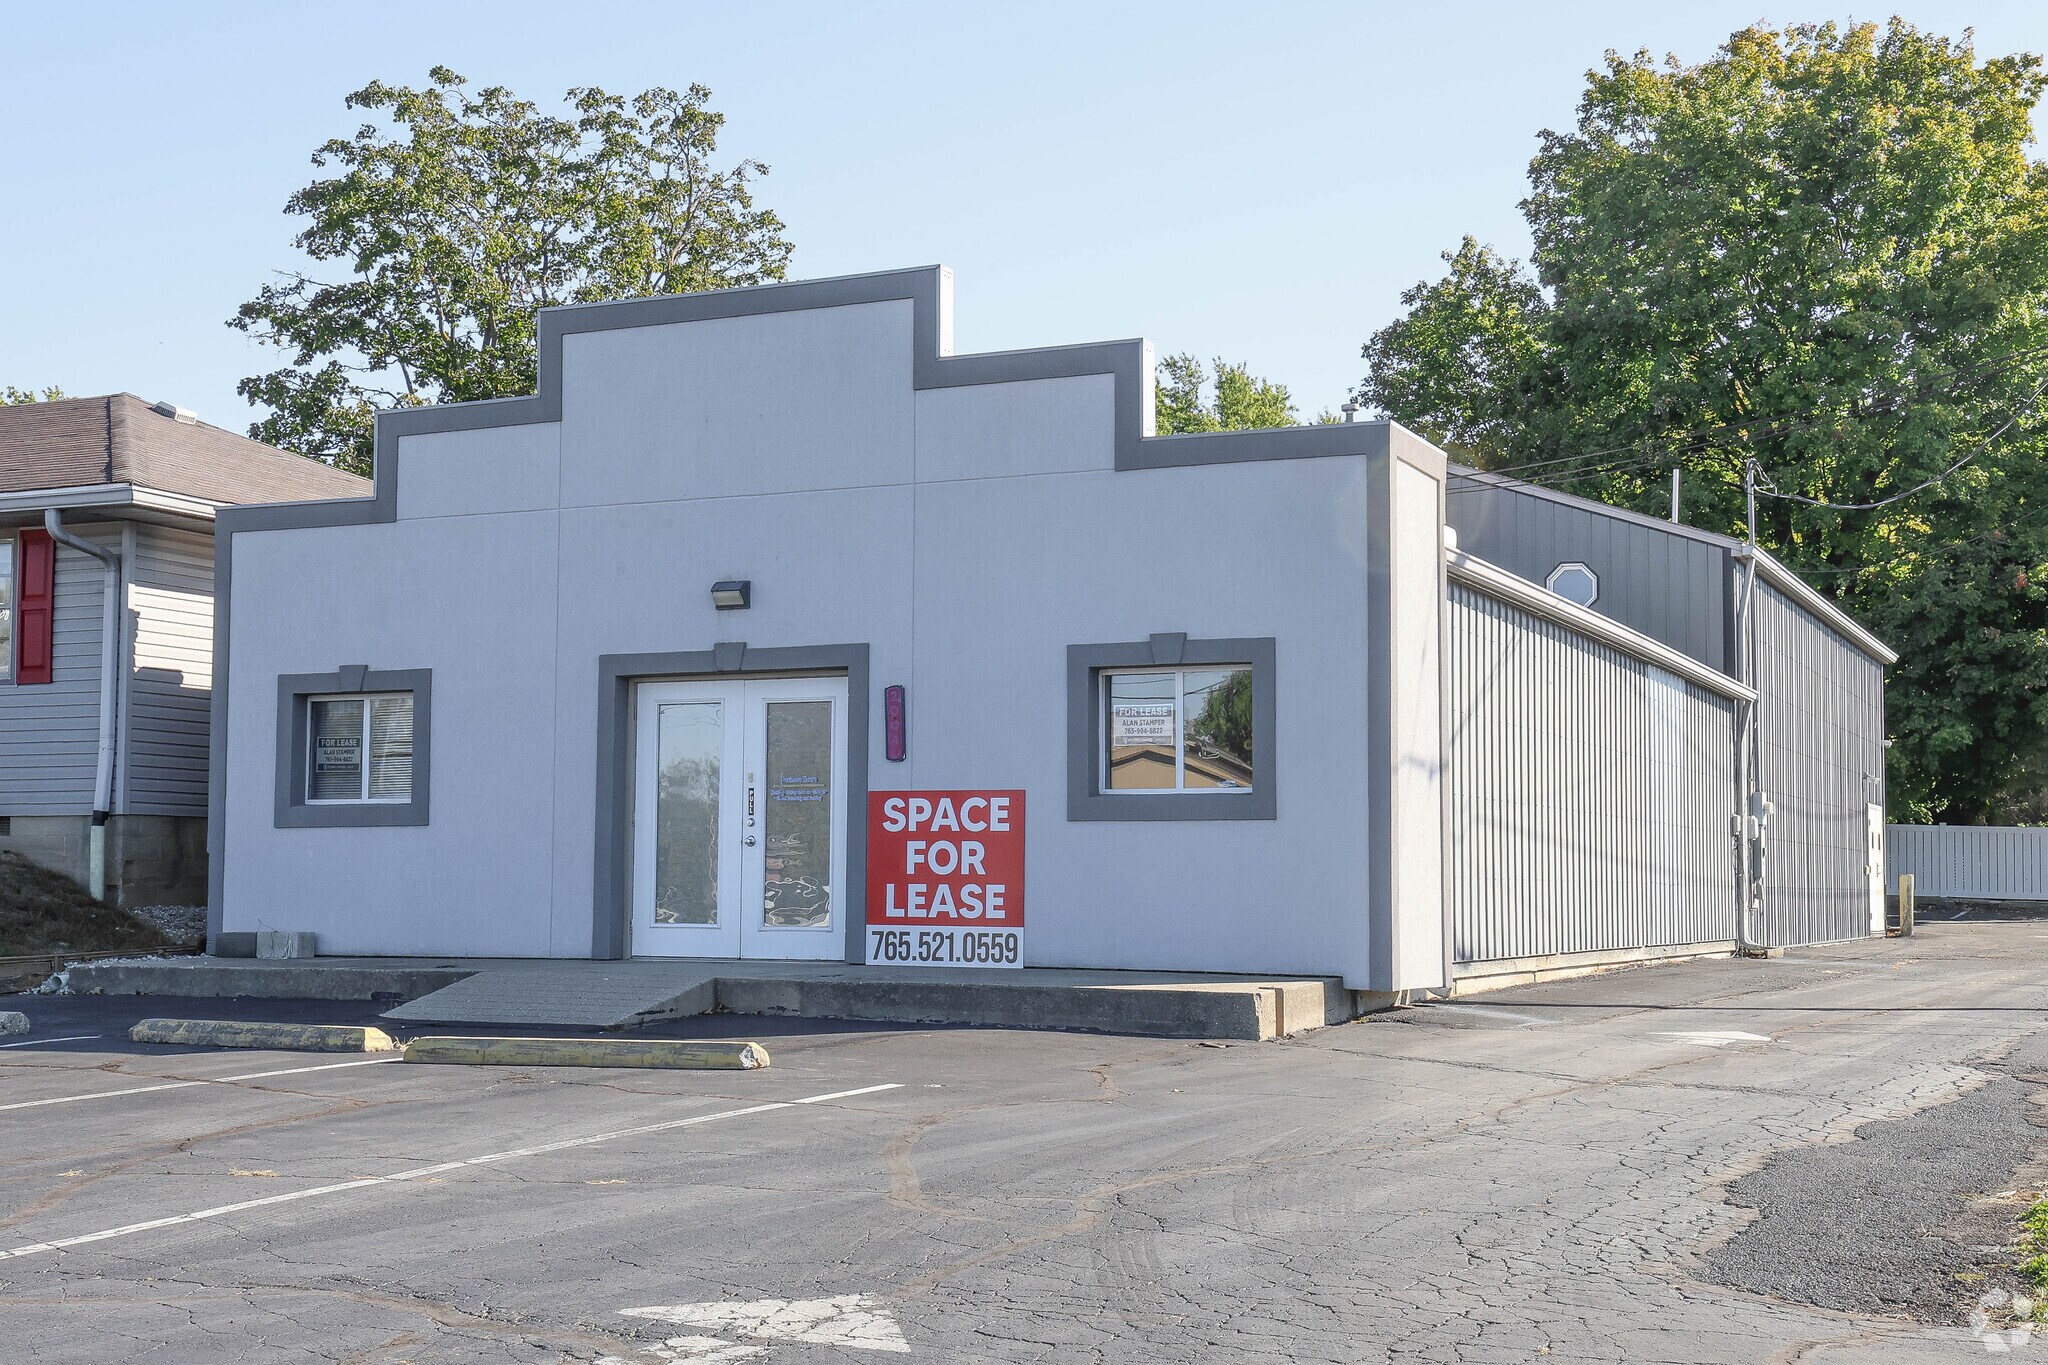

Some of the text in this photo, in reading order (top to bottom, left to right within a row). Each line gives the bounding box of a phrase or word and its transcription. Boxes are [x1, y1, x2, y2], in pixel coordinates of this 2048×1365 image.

[1119, 706, 1168, 716] FOR LEASE
[321, 738, 358, 747] FOR LEASE
[882, 797, 1010, 832] SPACE
[906, 840, 986, 875] FOR
[885, 883, 1006, 919] LEASE
[871, 930, 1018, 963] 765.521.0559
